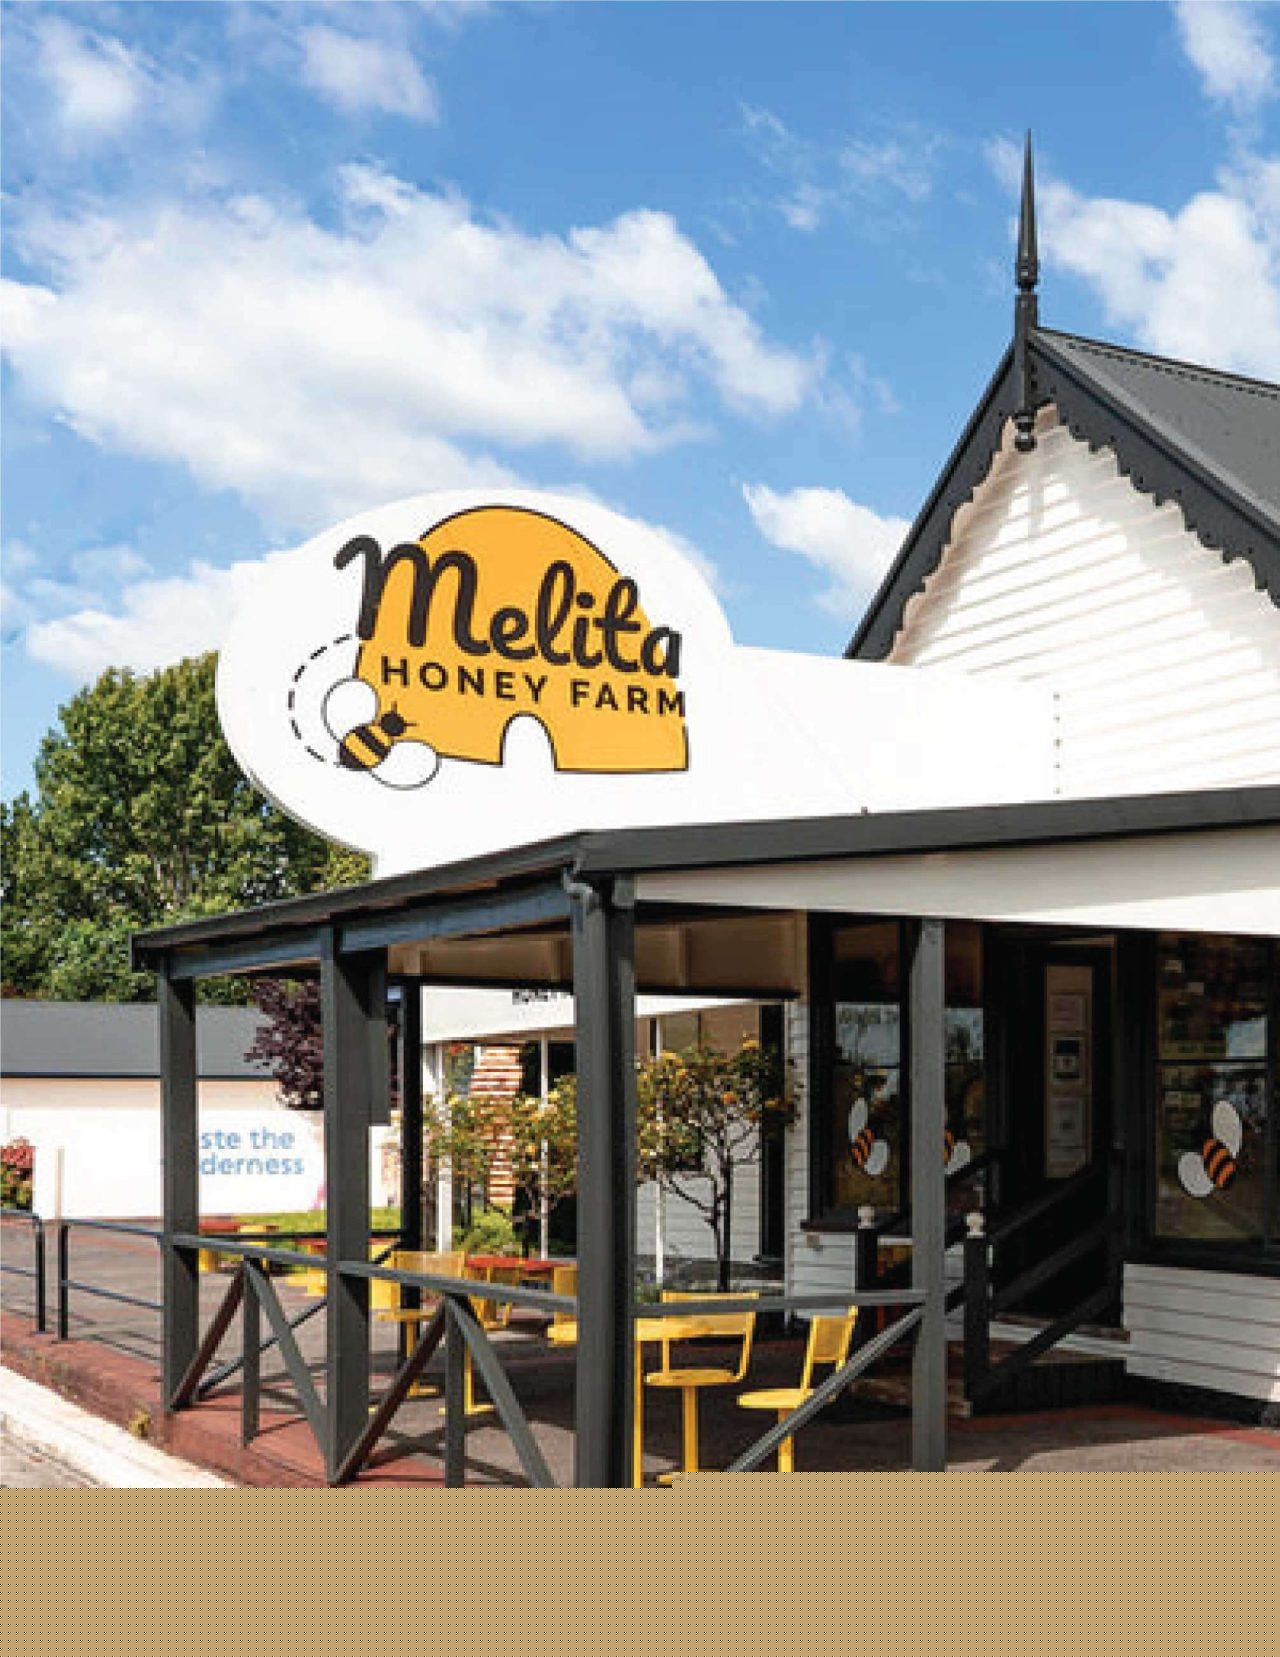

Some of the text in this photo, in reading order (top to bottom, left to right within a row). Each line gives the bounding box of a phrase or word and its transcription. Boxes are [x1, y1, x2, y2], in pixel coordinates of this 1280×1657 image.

[333, 535, 683, 678] Melita
[380, 655, 686, 718] HONEY FARM
[249, 1127, 296, 1150] the
